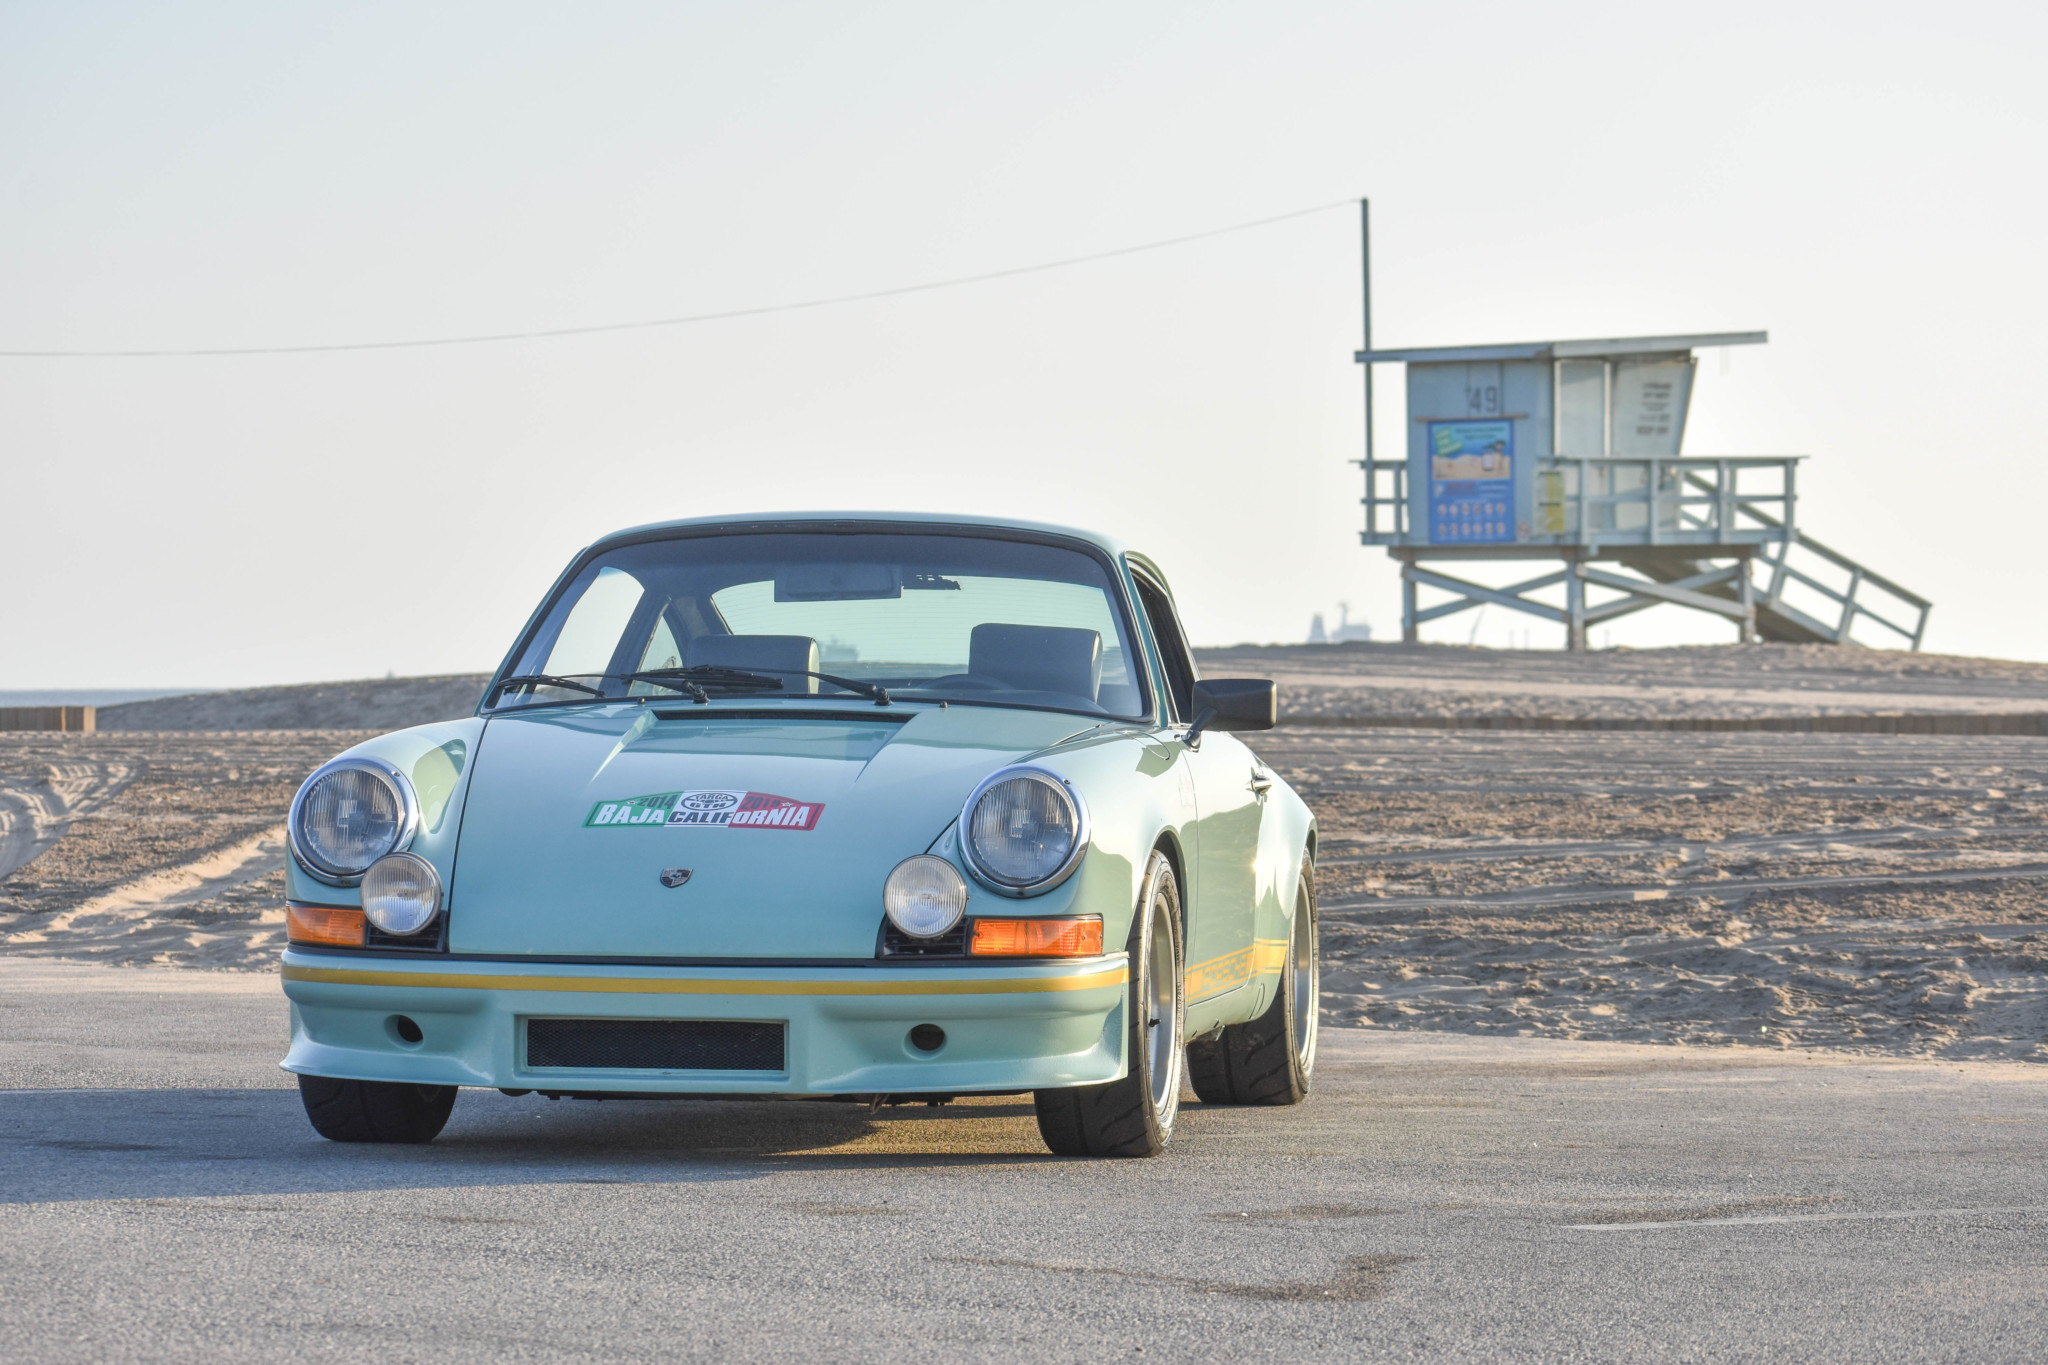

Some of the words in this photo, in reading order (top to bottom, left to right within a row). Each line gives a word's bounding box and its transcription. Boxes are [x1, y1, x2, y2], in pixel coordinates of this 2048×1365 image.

[1470, 385, 1498, 413] 49
[637, 795, 678, 810] 2014
[695, 793, 729, 801] TARGA
[594, 804, 665, 825] BAJA
[667, 806, 810, 827] CALIFORNIA
